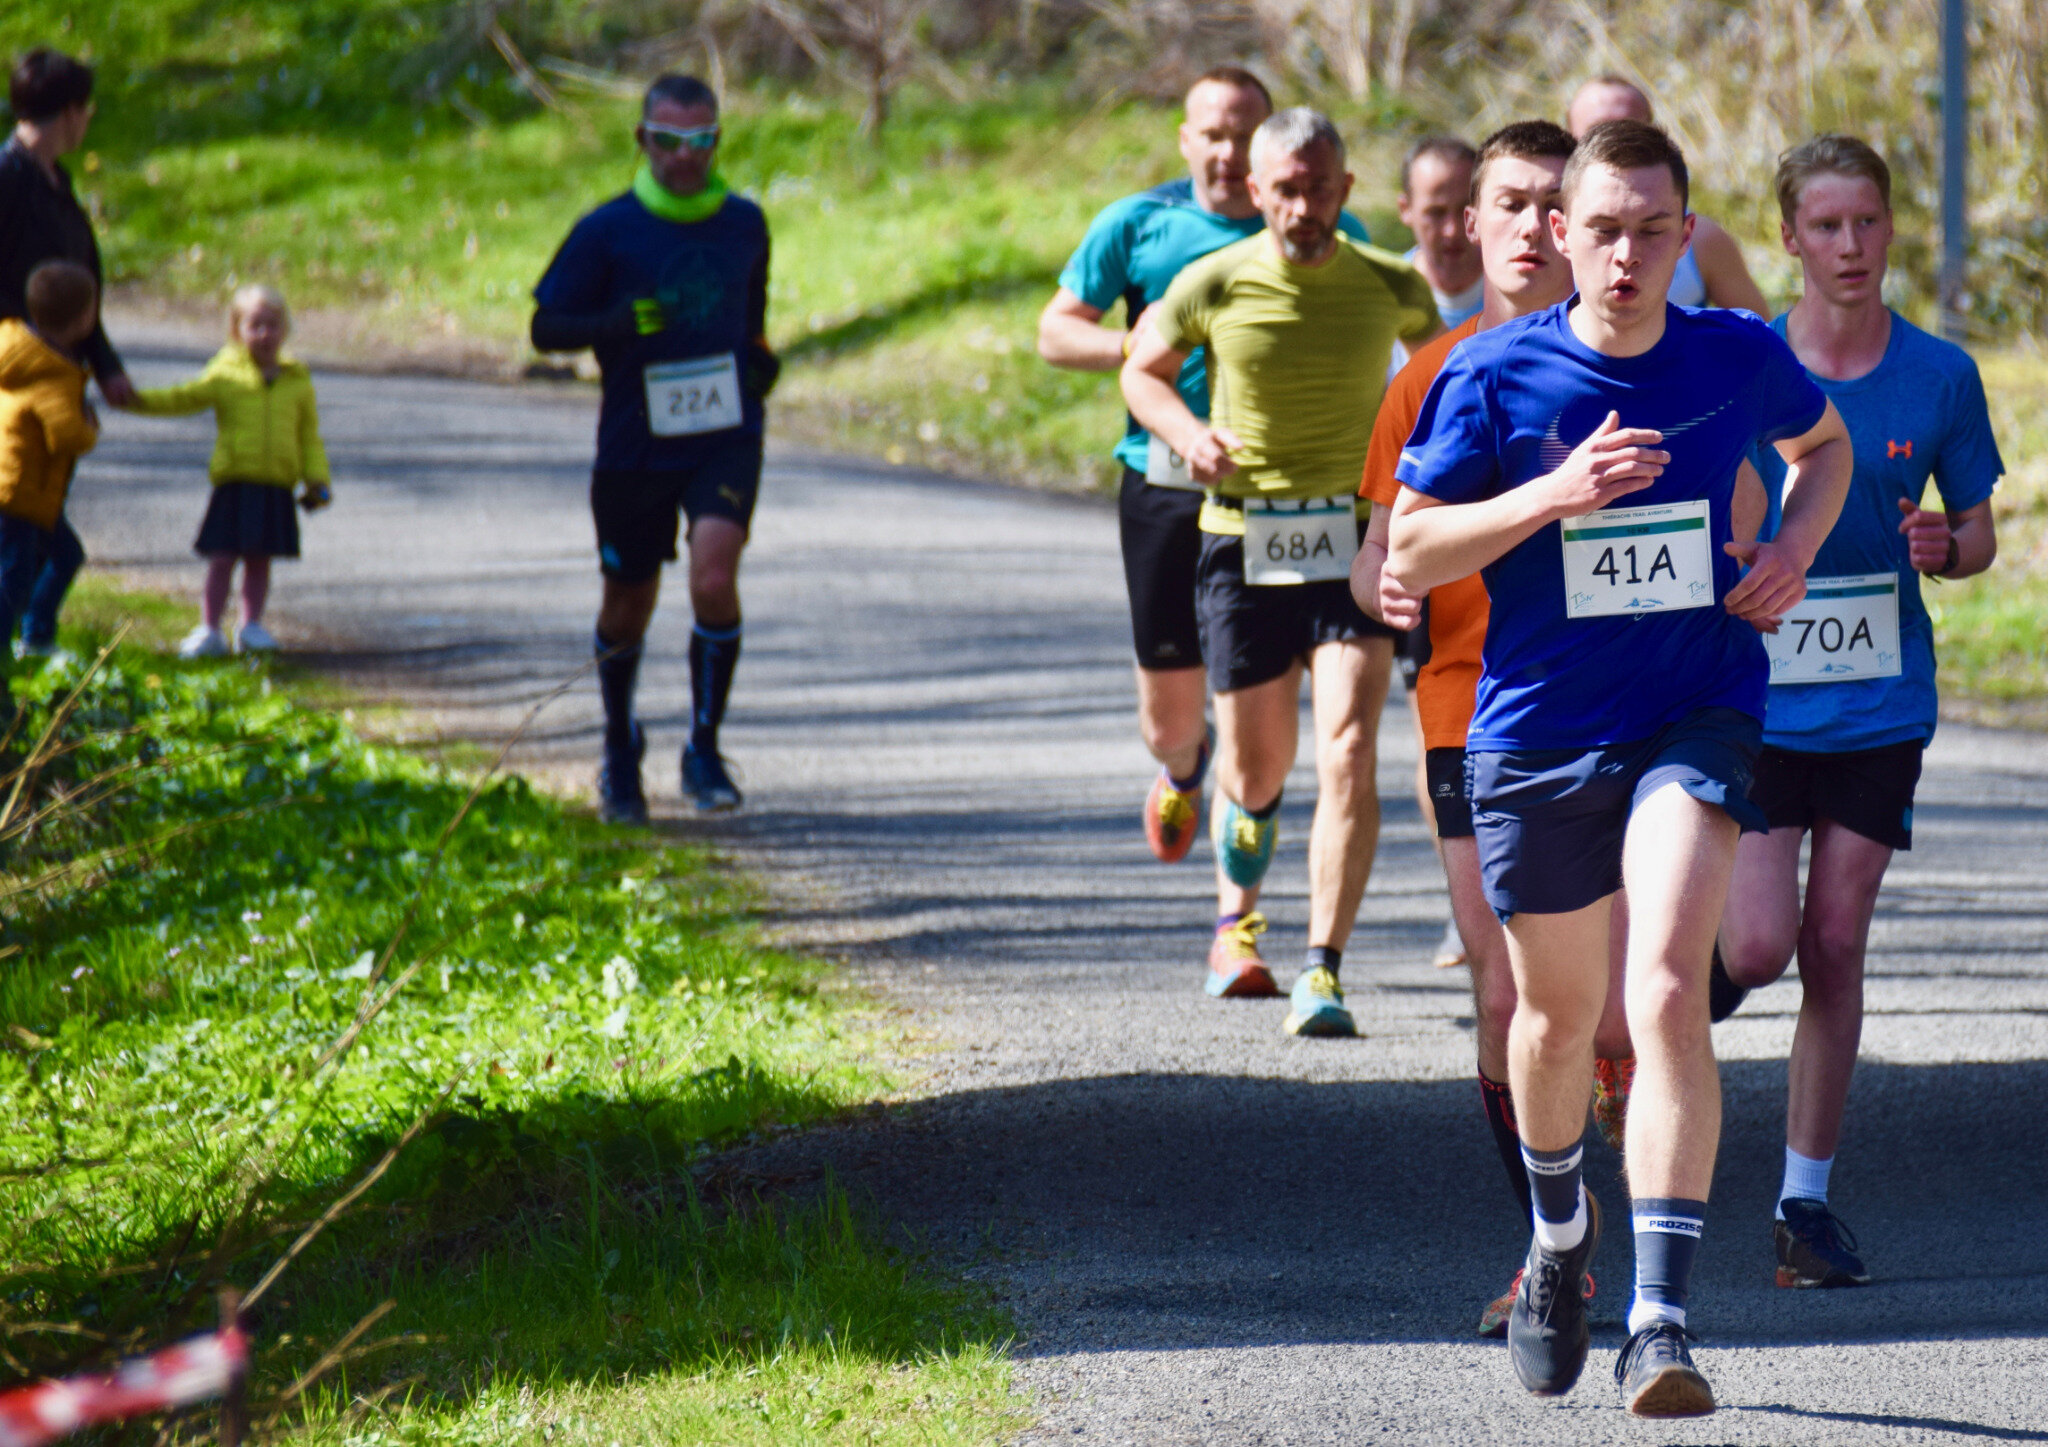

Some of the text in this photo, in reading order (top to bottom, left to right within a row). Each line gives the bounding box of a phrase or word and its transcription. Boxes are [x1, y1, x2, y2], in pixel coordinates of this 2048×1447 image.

[668, 386, 722, 415] 22A
[1267, 531, 1335, 562] 68A
[1592, 543, 1677, 586] 41A
[1791, 616, 1874, 654] 70A
